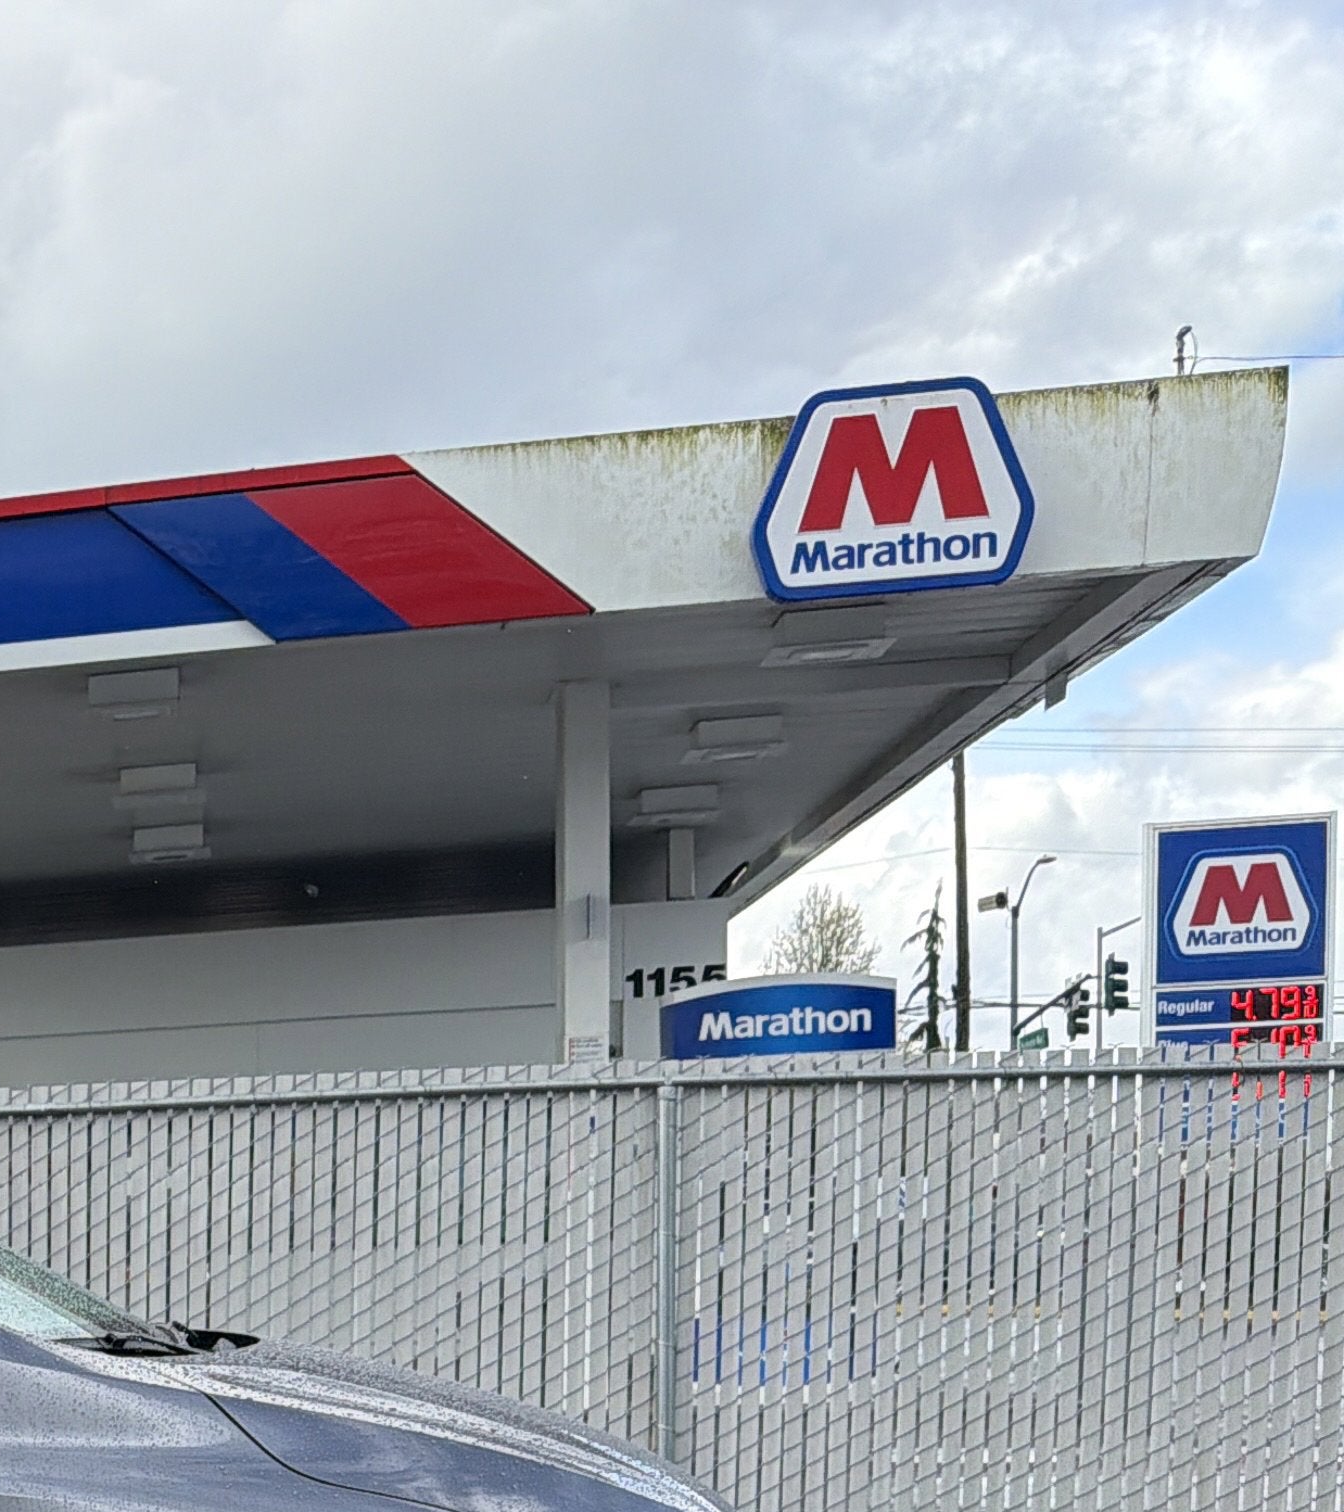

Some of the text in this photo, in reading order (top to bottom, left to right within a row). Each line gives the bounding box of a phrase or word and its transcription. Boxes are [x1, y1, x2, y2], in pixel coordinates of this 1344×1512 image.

[798, 405, 990, 533] M
[789, 531, 998, 575] Marathon
[1189, 861, 1294, 927] M
[1185, 926, 1297, 947] Marathon
[698, 1007, 872, 1041] Marathon
[1158, 999, 1215, 1017] Regular
